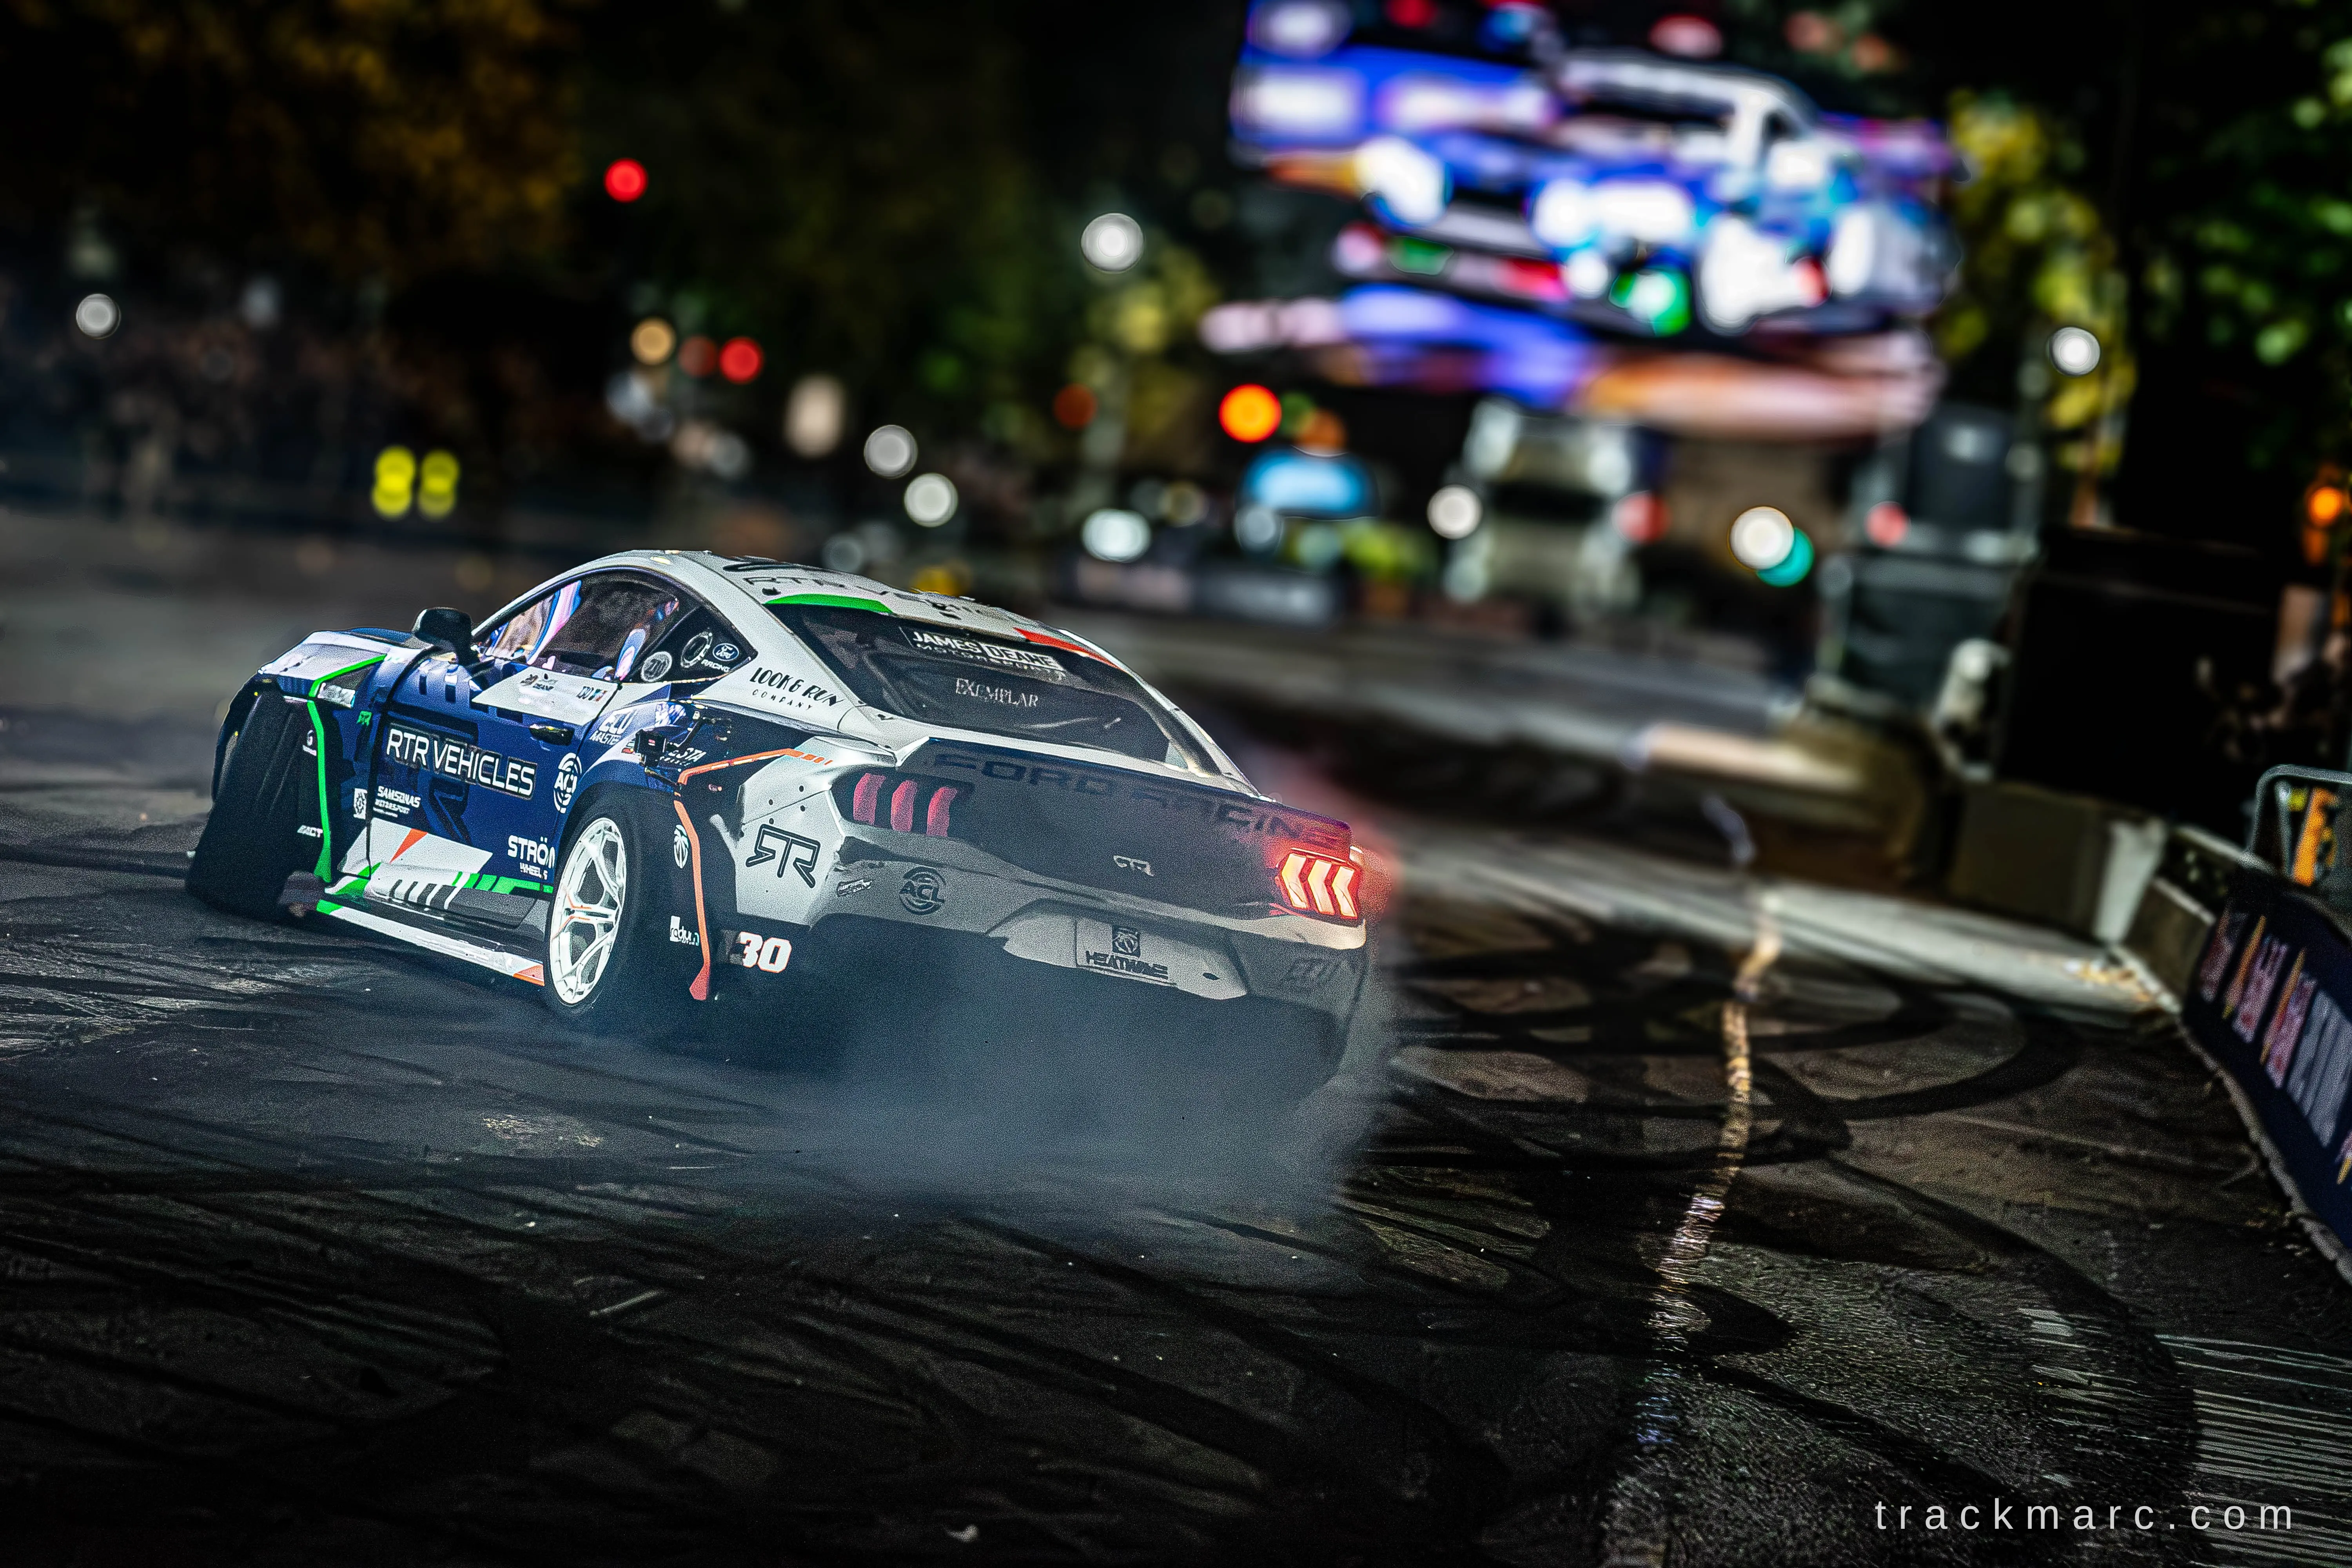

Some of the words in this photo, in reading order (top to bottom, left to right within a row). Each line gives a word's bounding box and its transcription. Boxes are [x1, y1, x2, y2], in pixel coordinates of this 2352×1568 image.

[913, 631, 982, 653] JAMES
[701, 659, 730, 673] RACING
[752, 689, 813, 711] COMPANY
[802, 685, 845, 707] RUN
[955, 677, 1039, 708] EXEMPLAR
[386, 728, 429, 766] RTR
[434, 740, 535, 796] VEHICLES
[730, 931, 792, 974] 30
